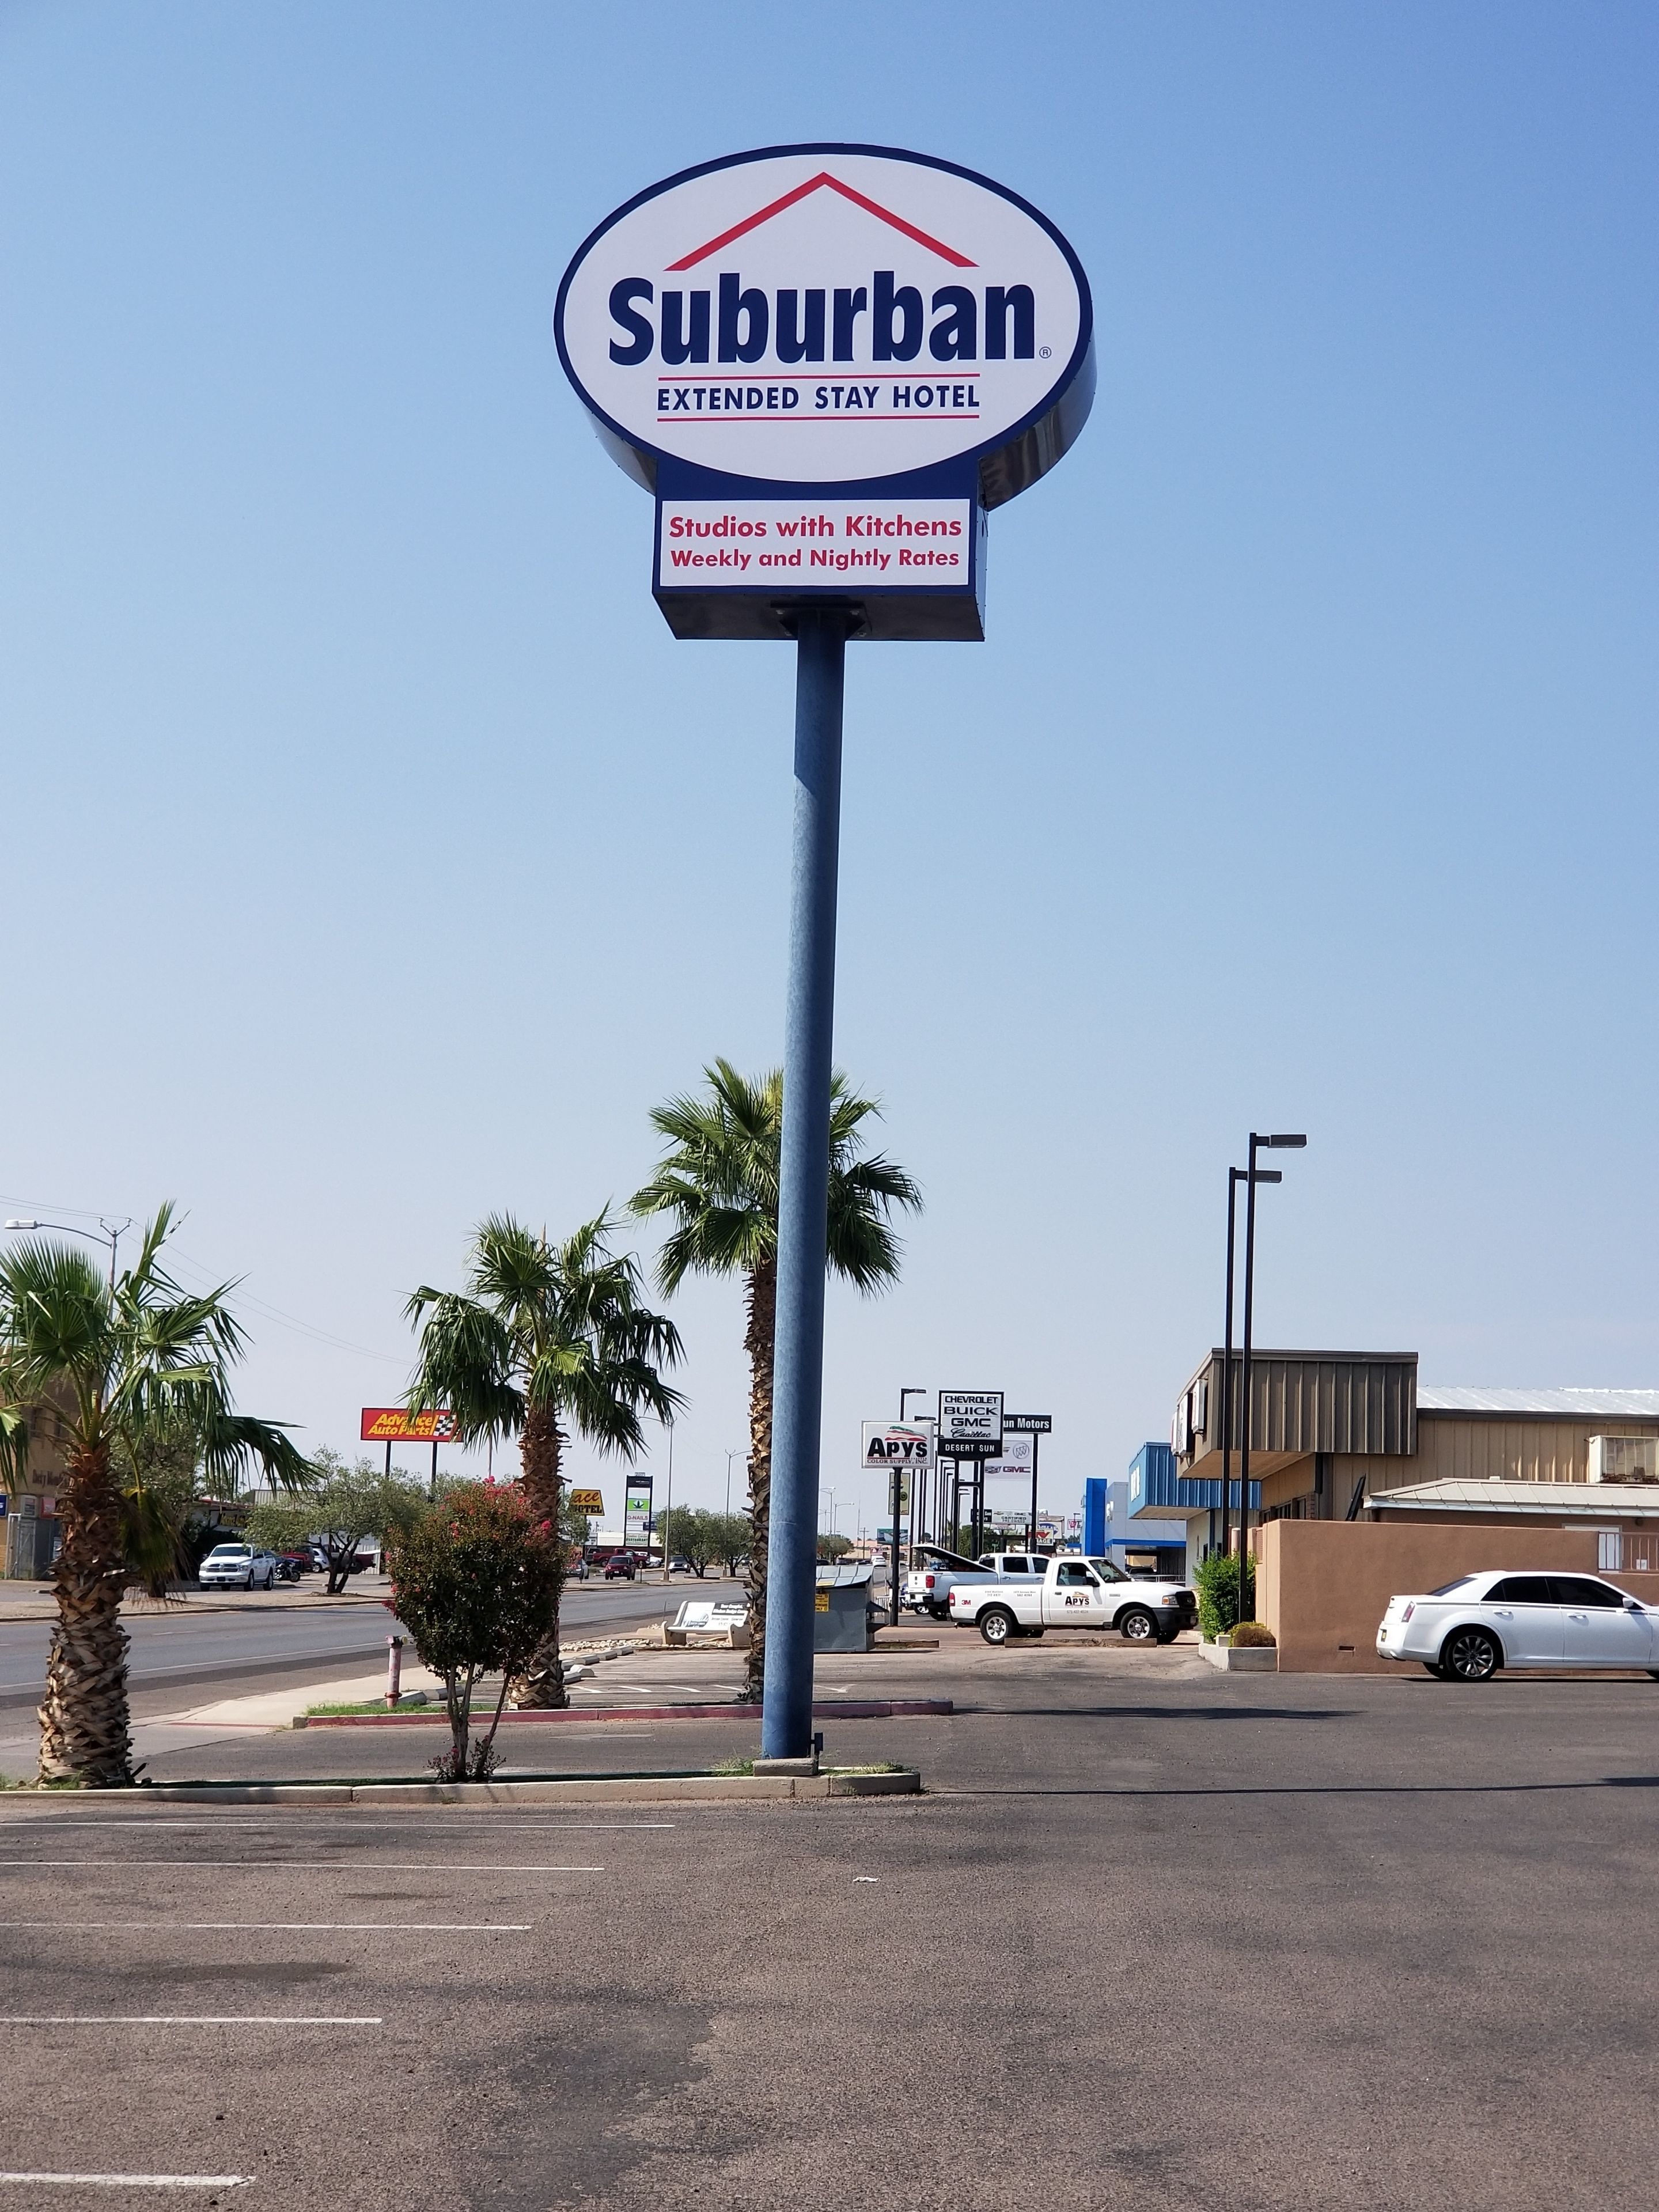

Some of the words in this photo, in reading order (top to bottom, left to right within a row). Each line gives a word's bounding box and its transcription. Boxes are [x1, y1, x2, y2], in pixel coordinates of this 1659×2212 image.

[609, 270, 1035, 366] Suburban
[657, 387, 800, 411] EXTENDED
[815, 385, 880, 410] STAY
[893, 384, 980, 408] HOTEL
[669, 515, 767, 538] Studios
[775, 514, 835, 537] with
[846, 514, 963, 537] Kitchens
[670, 548, 752, 571] Weekly
[758, 548, 802, 567] and
[810, 548, 892, 571] Nightly
[899, 548, 960, 566] Rates
[945, 1395, 999, 1404] CHEVROLET
[944, 1406, 999, 1416] BUICK
[950, 1418, 991, 1427] GMC
[1017, 1418, 1050, 1429] Motors
[367, 1425, 398, 1435] Auto
[945, 1444, 975, 1452] DESERT
